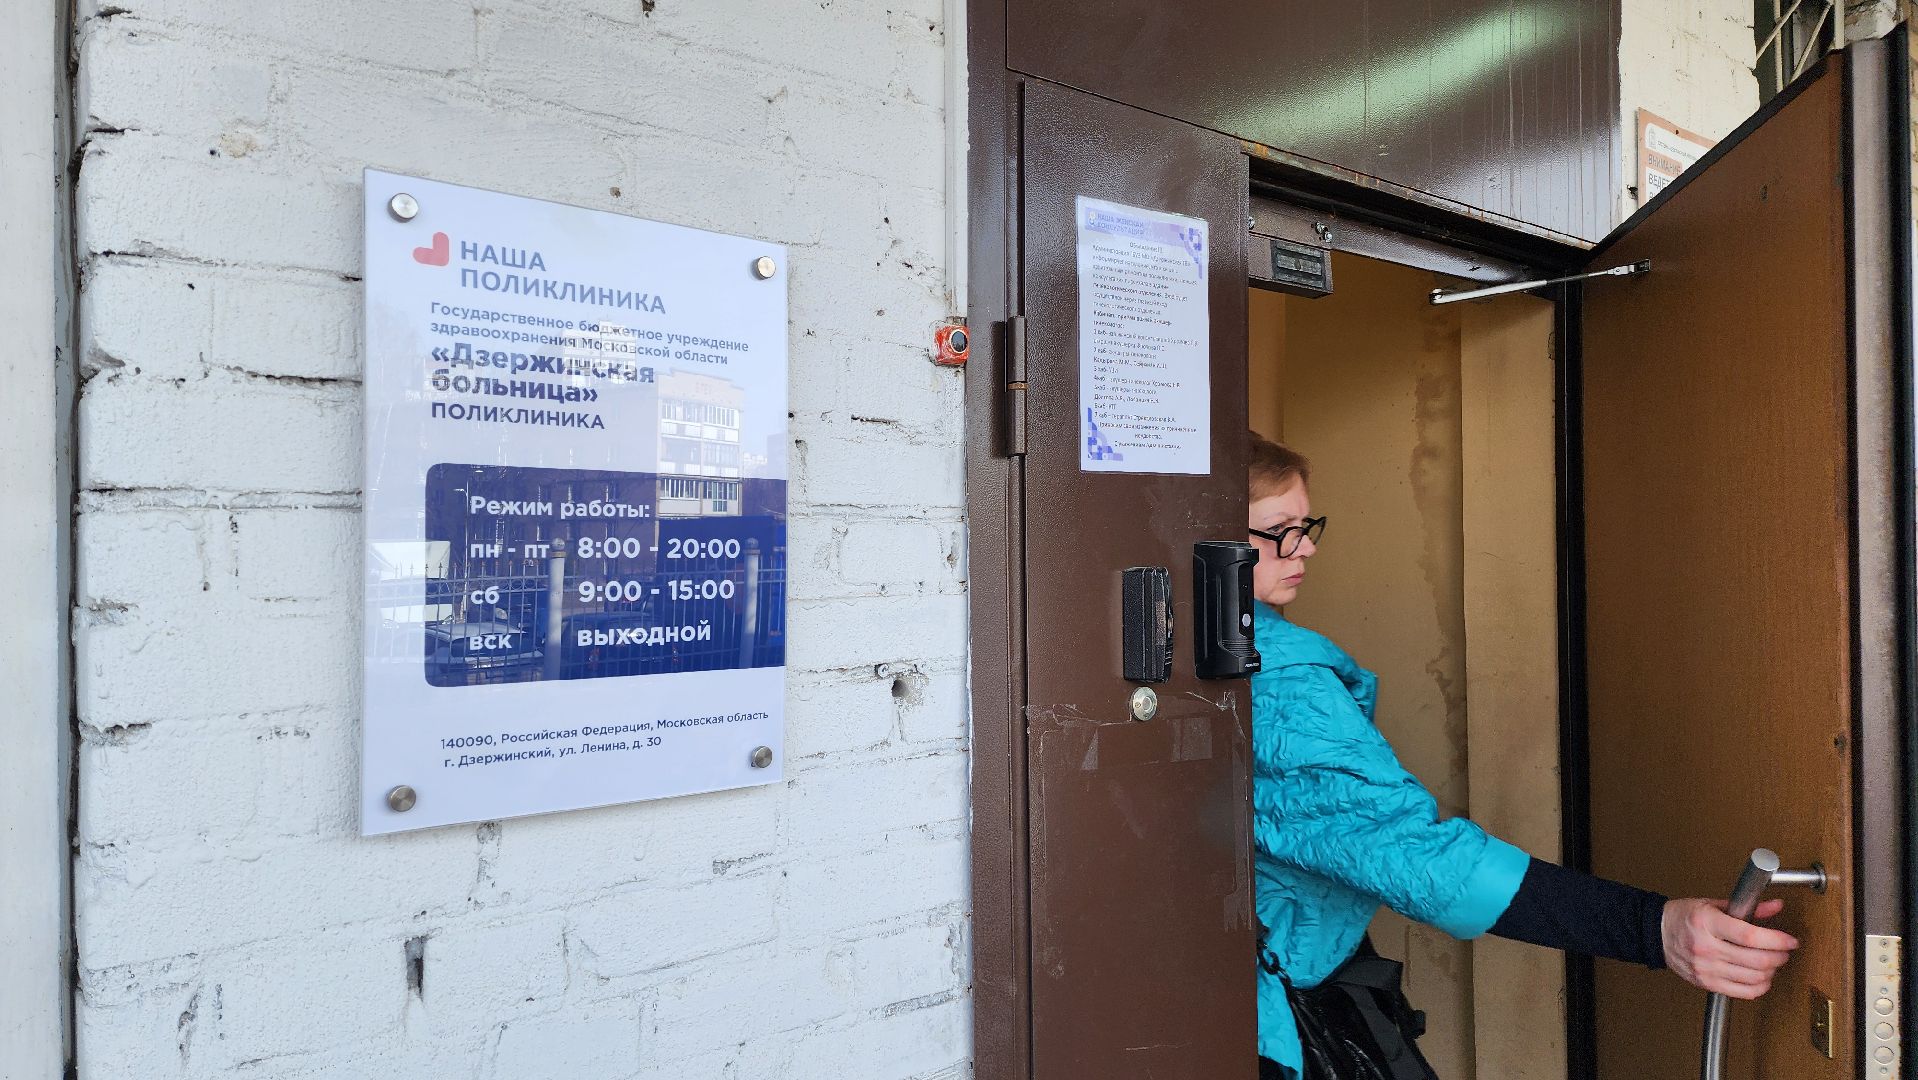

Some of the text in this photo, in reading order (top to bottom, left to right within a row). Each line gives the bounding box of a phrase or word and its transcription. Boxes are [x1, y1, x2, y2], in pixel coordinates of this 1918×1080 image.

[461, 240, 546, 272] НАША
[461, 268, 666, 314] ПОЛИКЛИНИКА
[431, 302, 749, 352] Государственное бюджетное учреждение
[431, 322, 728, 365] здравоохранения Московской области
[432, 368, 598, 404] больница»
[431, 402, 605, 429] ПОЛИКЛИНИКА
[470, 496, 650, 519] Режим работы:
[470, 543, 499, 559] пн
[524, 543, 550, 559] пт
[577, 537, 641, 559] 8:00
[667, 538, 740, 559] 20:00
[470, 585, 500, 604] сб
[578, 580, 642, 603] 9:00
[667, 579, 735, 601] 15:00
[469, 620, 711, 650] вск выходной
[441, 710, 769, 749] 140090, Российская Федерация, Московская область
[444, 736, 661, 768] г. Дзержинский, ул. Ленина, д. 30
